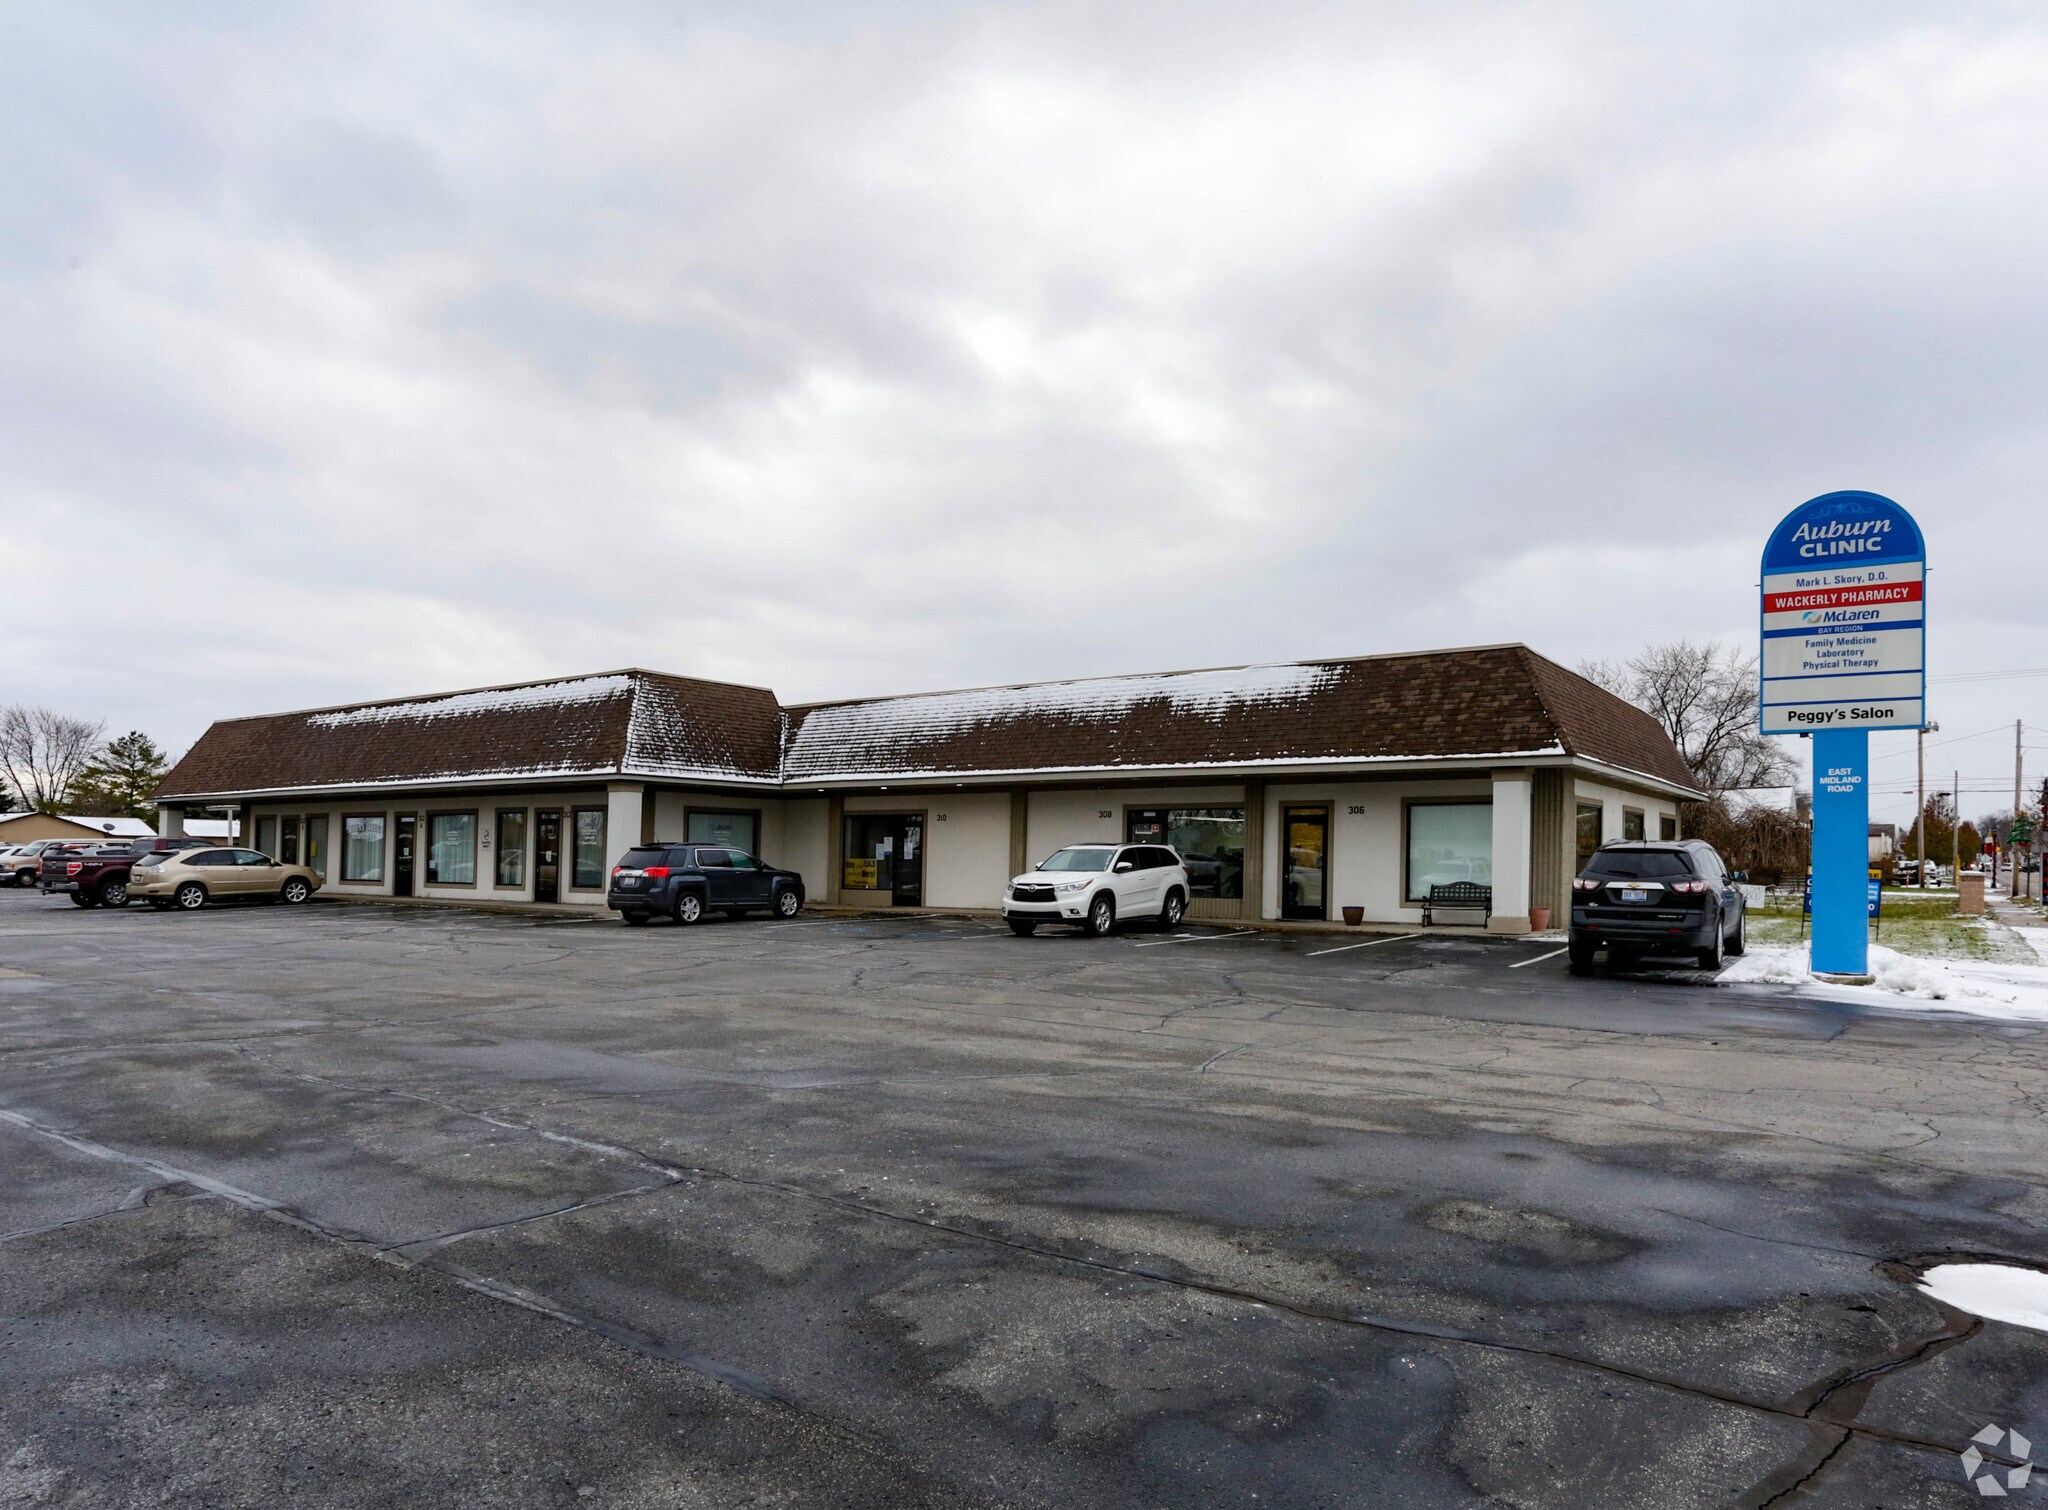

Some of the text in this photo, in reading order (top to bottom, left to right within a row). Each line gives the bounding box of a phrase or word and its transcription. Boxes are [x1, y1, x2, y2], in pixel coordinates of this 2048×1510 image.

[1791, 519, 1892, 542] Auburn
[1799, 537, 1882, 558] CLINIC
[1796, 571, 1888, 588] Mark L. Skory, D.O.
[1775, 587, 1909, 608] WACKERLY PHARMACY
[1823, 609, 1880, 623] McLaren
[1818, 625, 1863, 634] BAY REGION
[1805, 636, 1877, 648] Family Medicine
[1817, 649, 1865, 658] Laboratory
[1803, 659, 1879, 670] Physical Therapy
[1788, 707, 1894, 724] Peggy's Salon
[1828, 768, 1852, 776] EAST
[1819, 776, 1862, 785] MIDLAND
[1827, 785, 1854, 793] ROAD
[1098, 810, 1112, 819] 308
[1348, 805, 1365, 814] 306
[936, 814, 947, 822] 310
